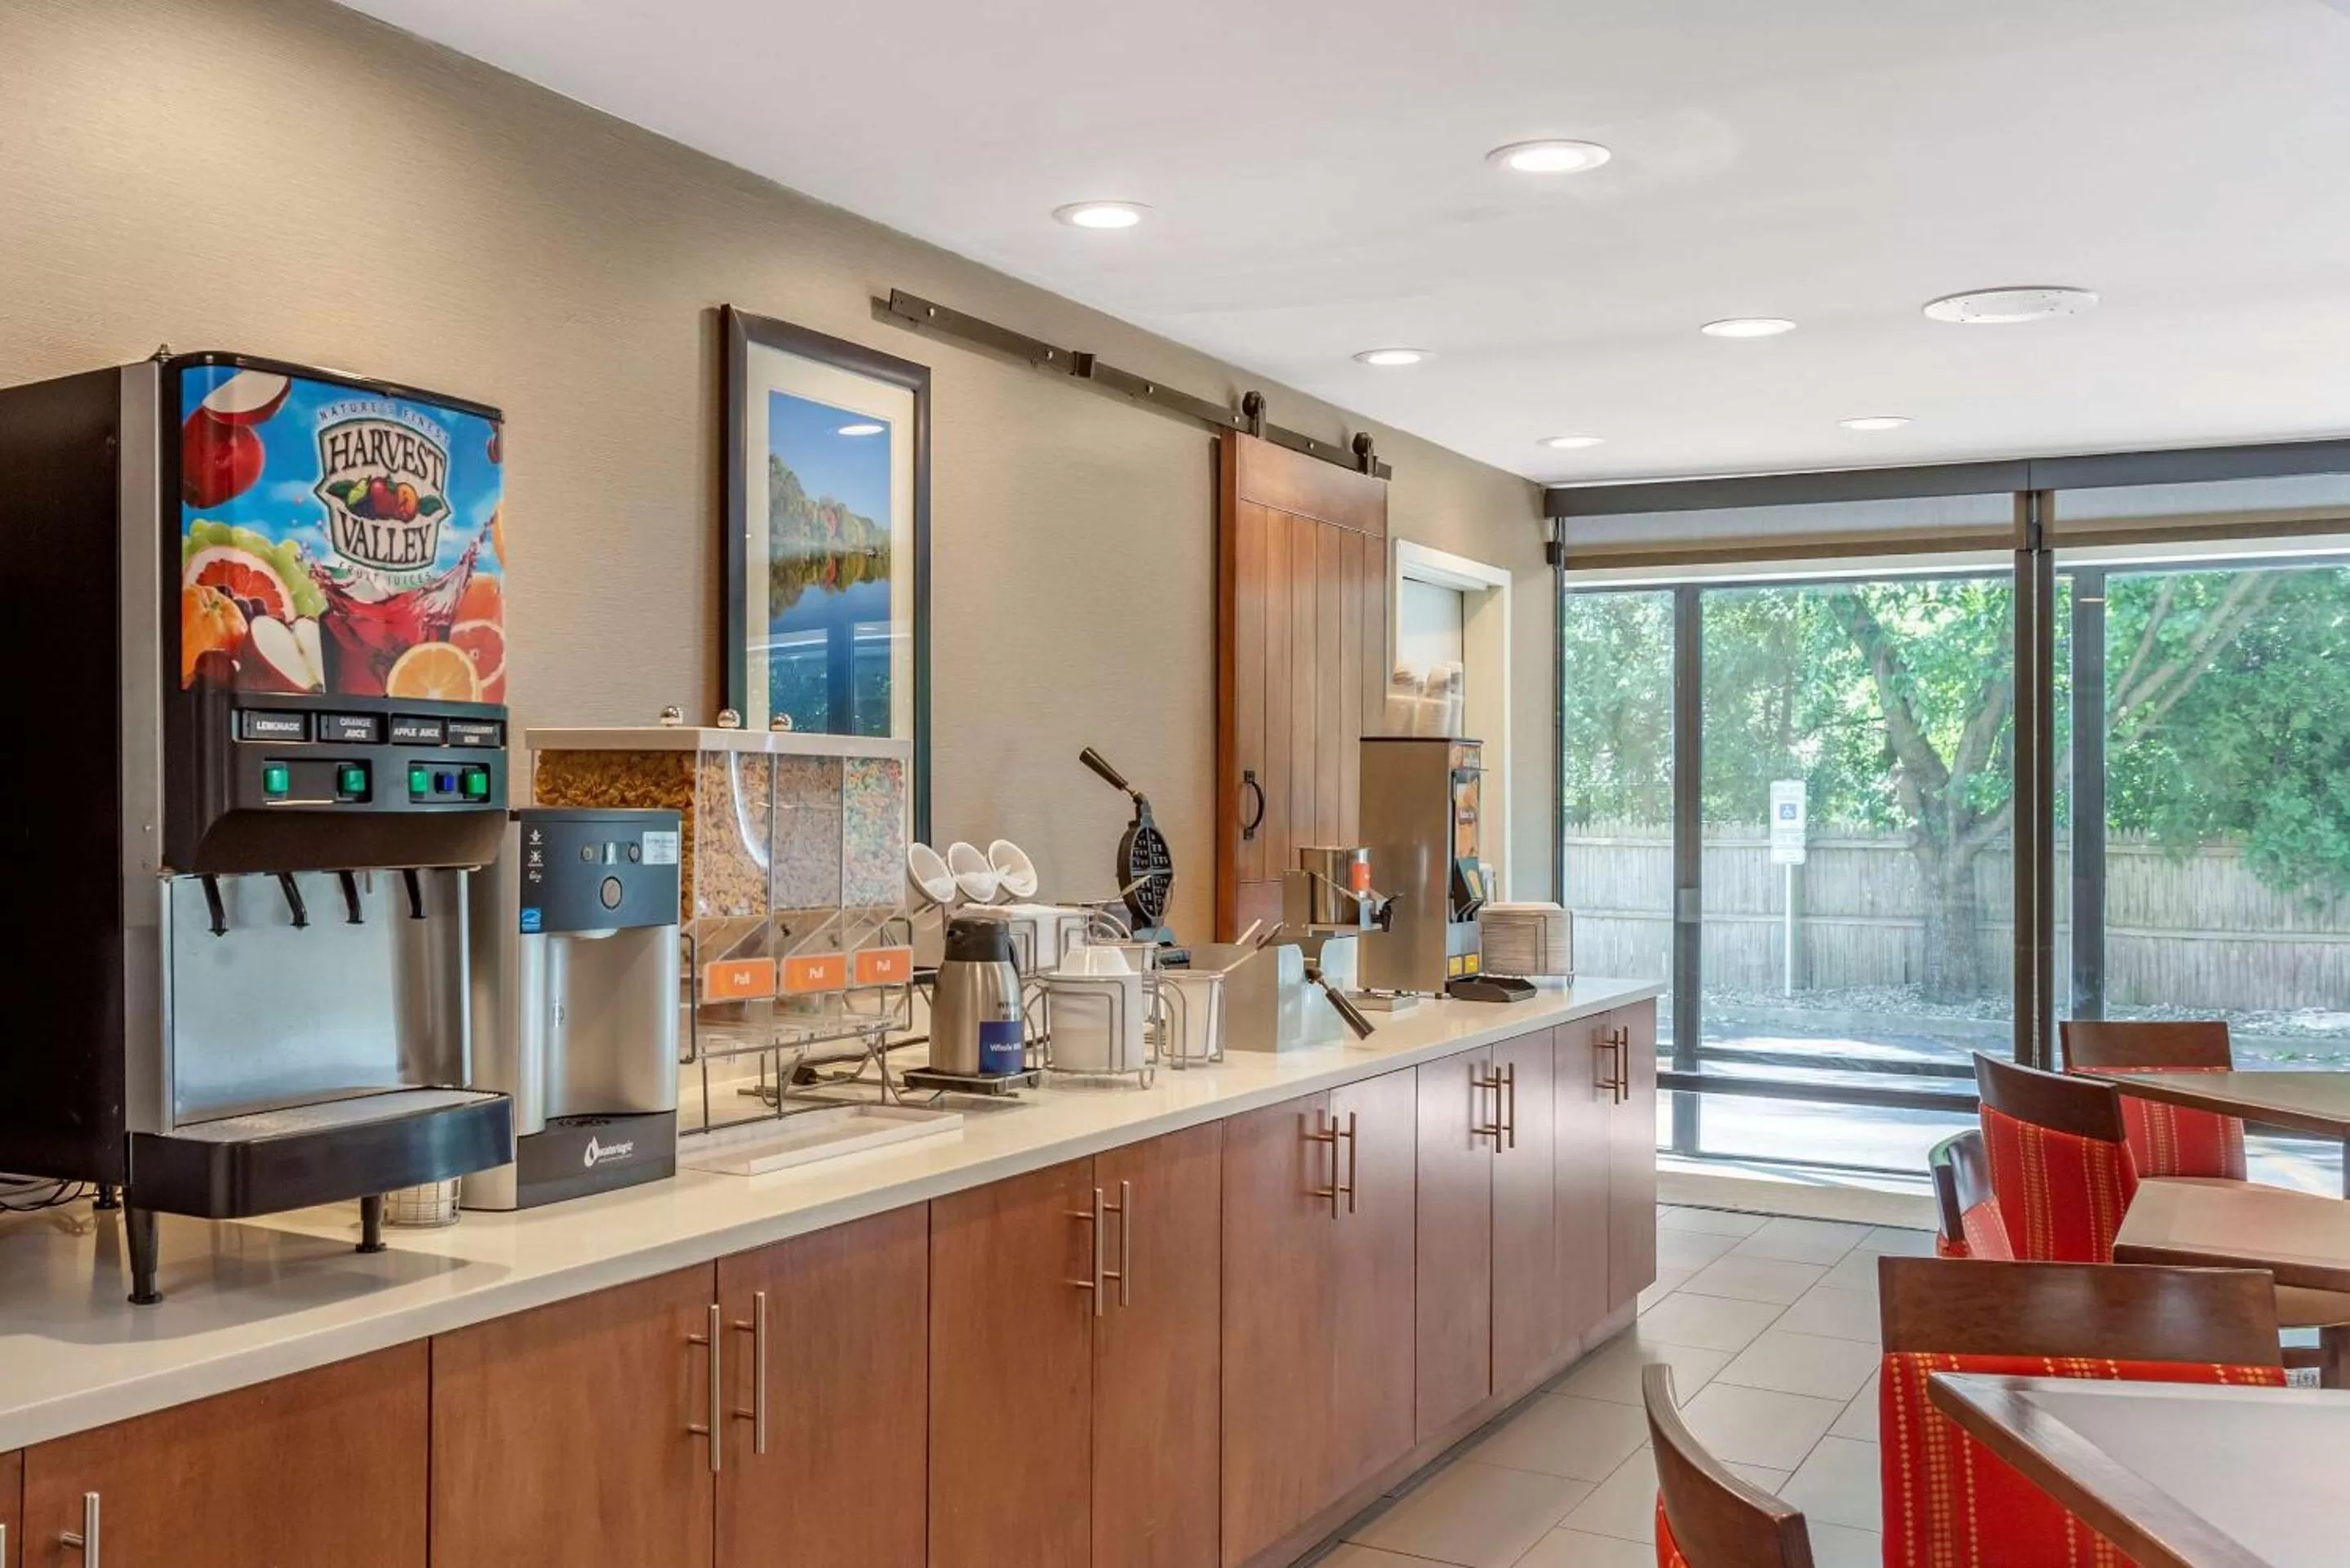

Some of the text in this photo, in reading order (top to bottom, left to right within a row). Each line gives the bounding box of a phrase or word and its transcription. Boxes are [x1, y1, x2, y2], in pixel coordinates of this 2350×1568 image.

[329, 429, 443, 490] HARVEST
[337, 508, 432, 564] VALLEY
[338, 562, 431, 586] FRUIT JUICES
[256, 721, 300, 731] LEMONADE
[340, 717, 372, 727] ORANGE
[344, 729, 366, 738] JUICE
[393, 727, 439, 737] APPLE JUICE
[877, 960, 891, 971] Pull
[735, 972, 750, 985] Pull
[809, 966, 824, 979] Pull
